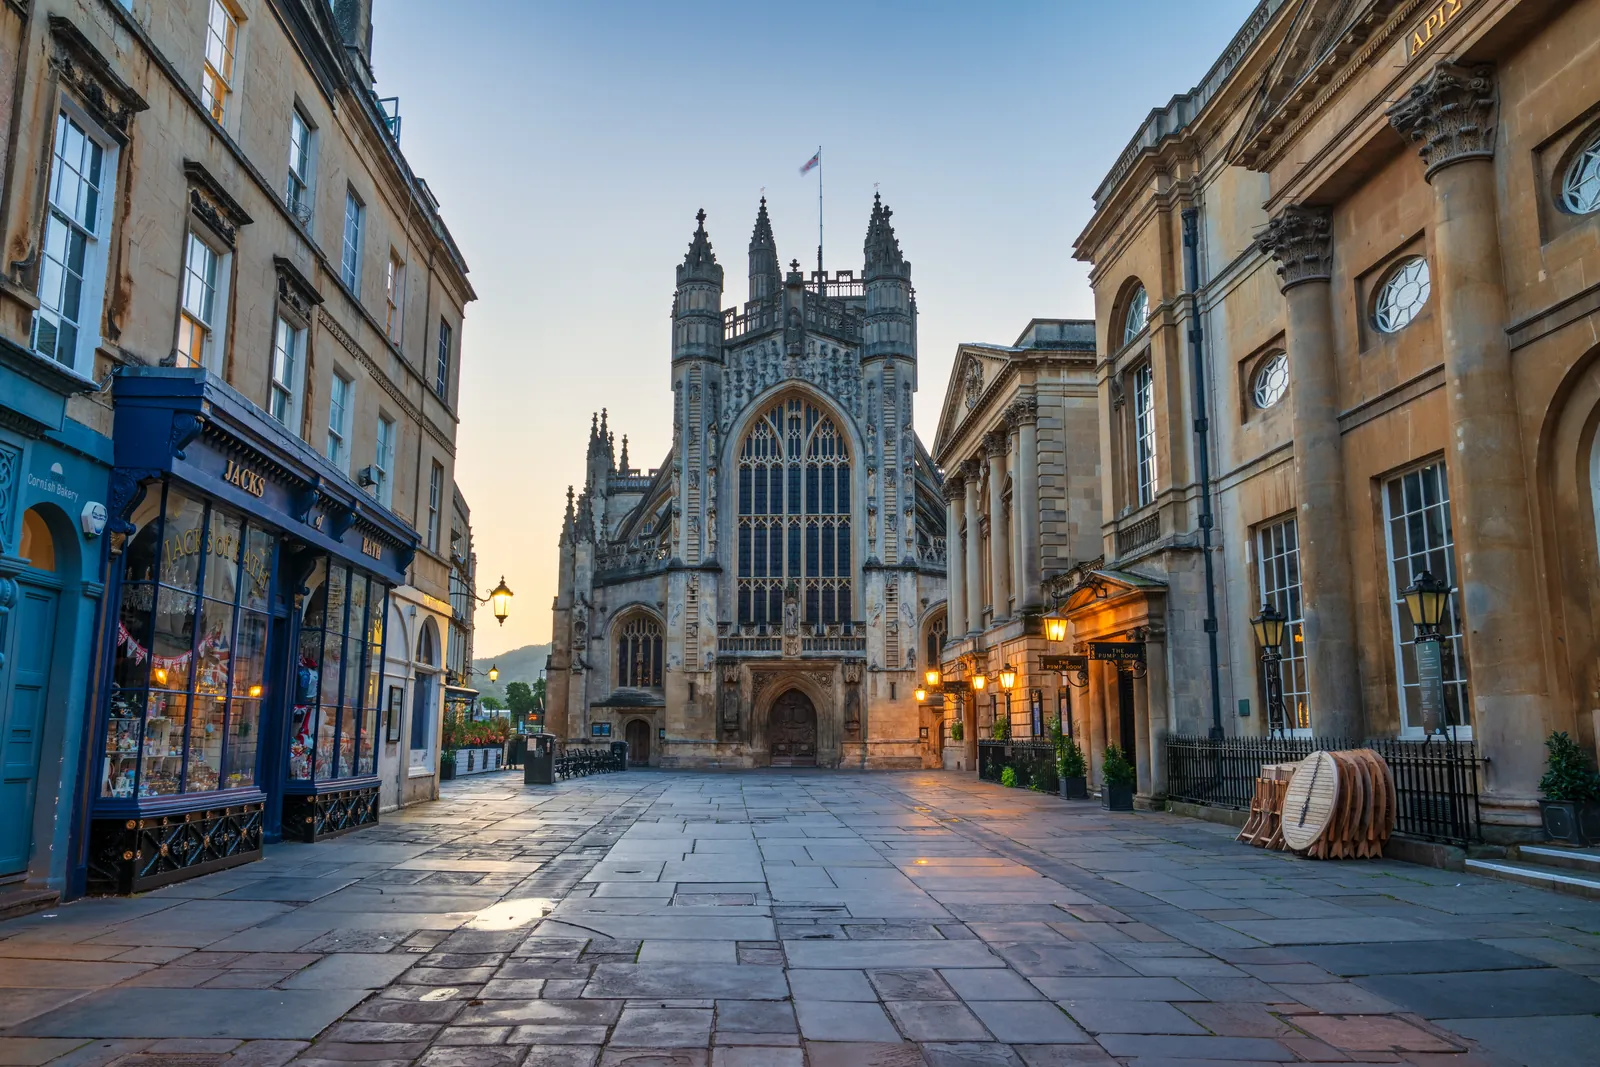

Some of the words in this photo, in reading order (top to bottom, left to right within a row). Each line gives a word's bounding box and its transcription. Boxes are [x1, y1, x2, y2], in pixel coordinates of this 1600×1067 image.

[27, 473, 56, 493] Cornish
[56, 484, 79, 503] Bakery
[224, 459, 266, 498] JACKS
[315, 514, 325, 530] of
[362, 537, 382, 560] BATH
[215, 533, 232, 559] of
